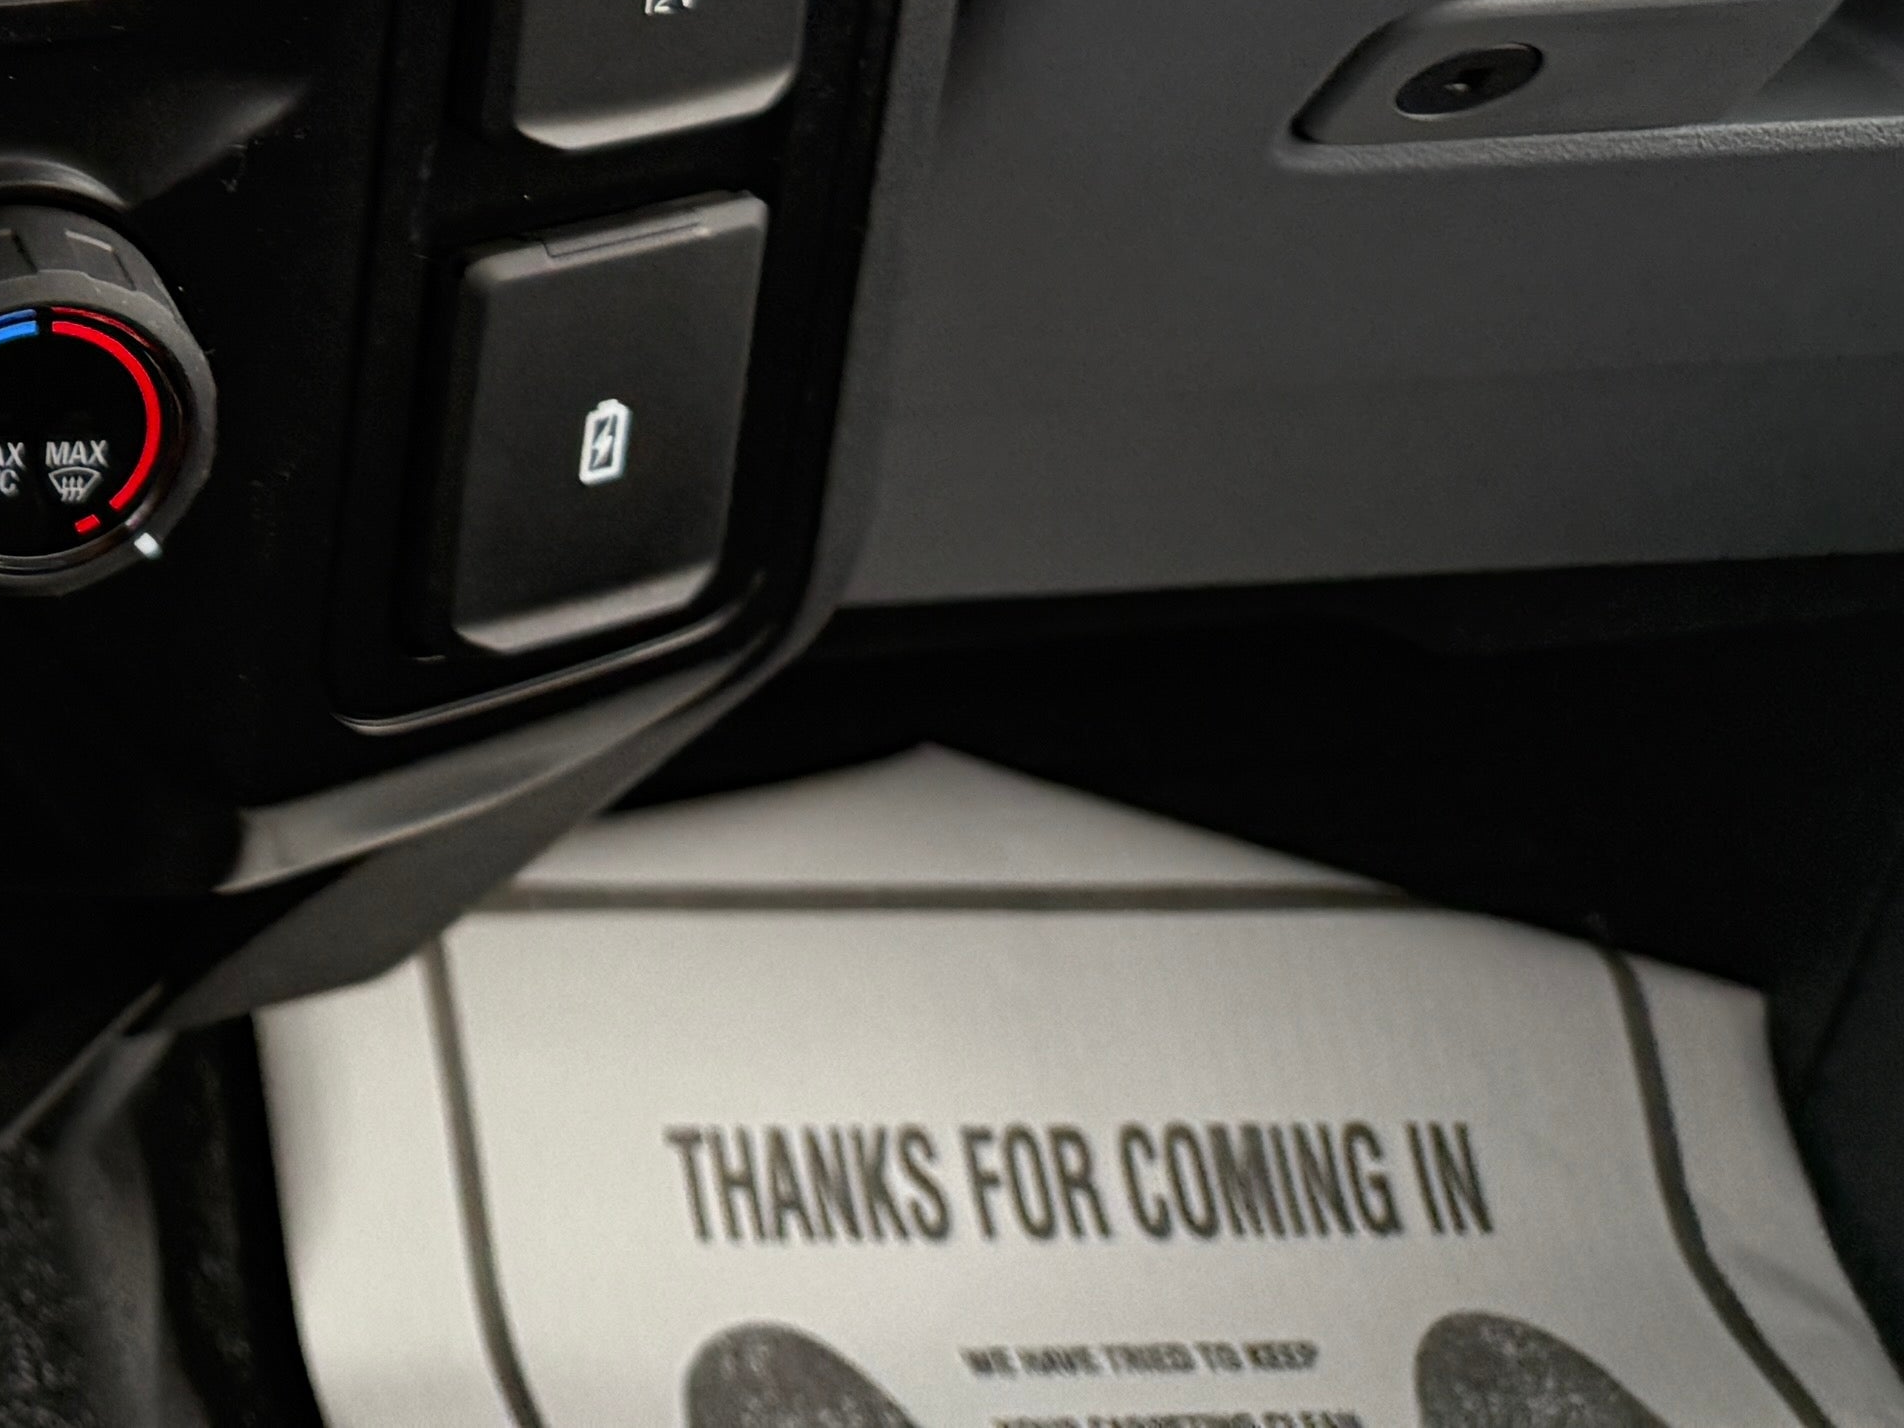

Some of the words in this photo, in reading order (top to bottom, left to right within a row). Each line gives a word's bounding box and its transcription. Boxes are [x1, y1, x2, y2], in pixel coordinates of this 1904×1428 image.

[46, 440, 107, 467] MAX
[666, 1124, 952, 1245] THANKS
[960, 1124, 1113, 1242] FOR
[1120, 1120, 1405, 1241] COMING
[1404, 1122, 1494, 1236] IN
